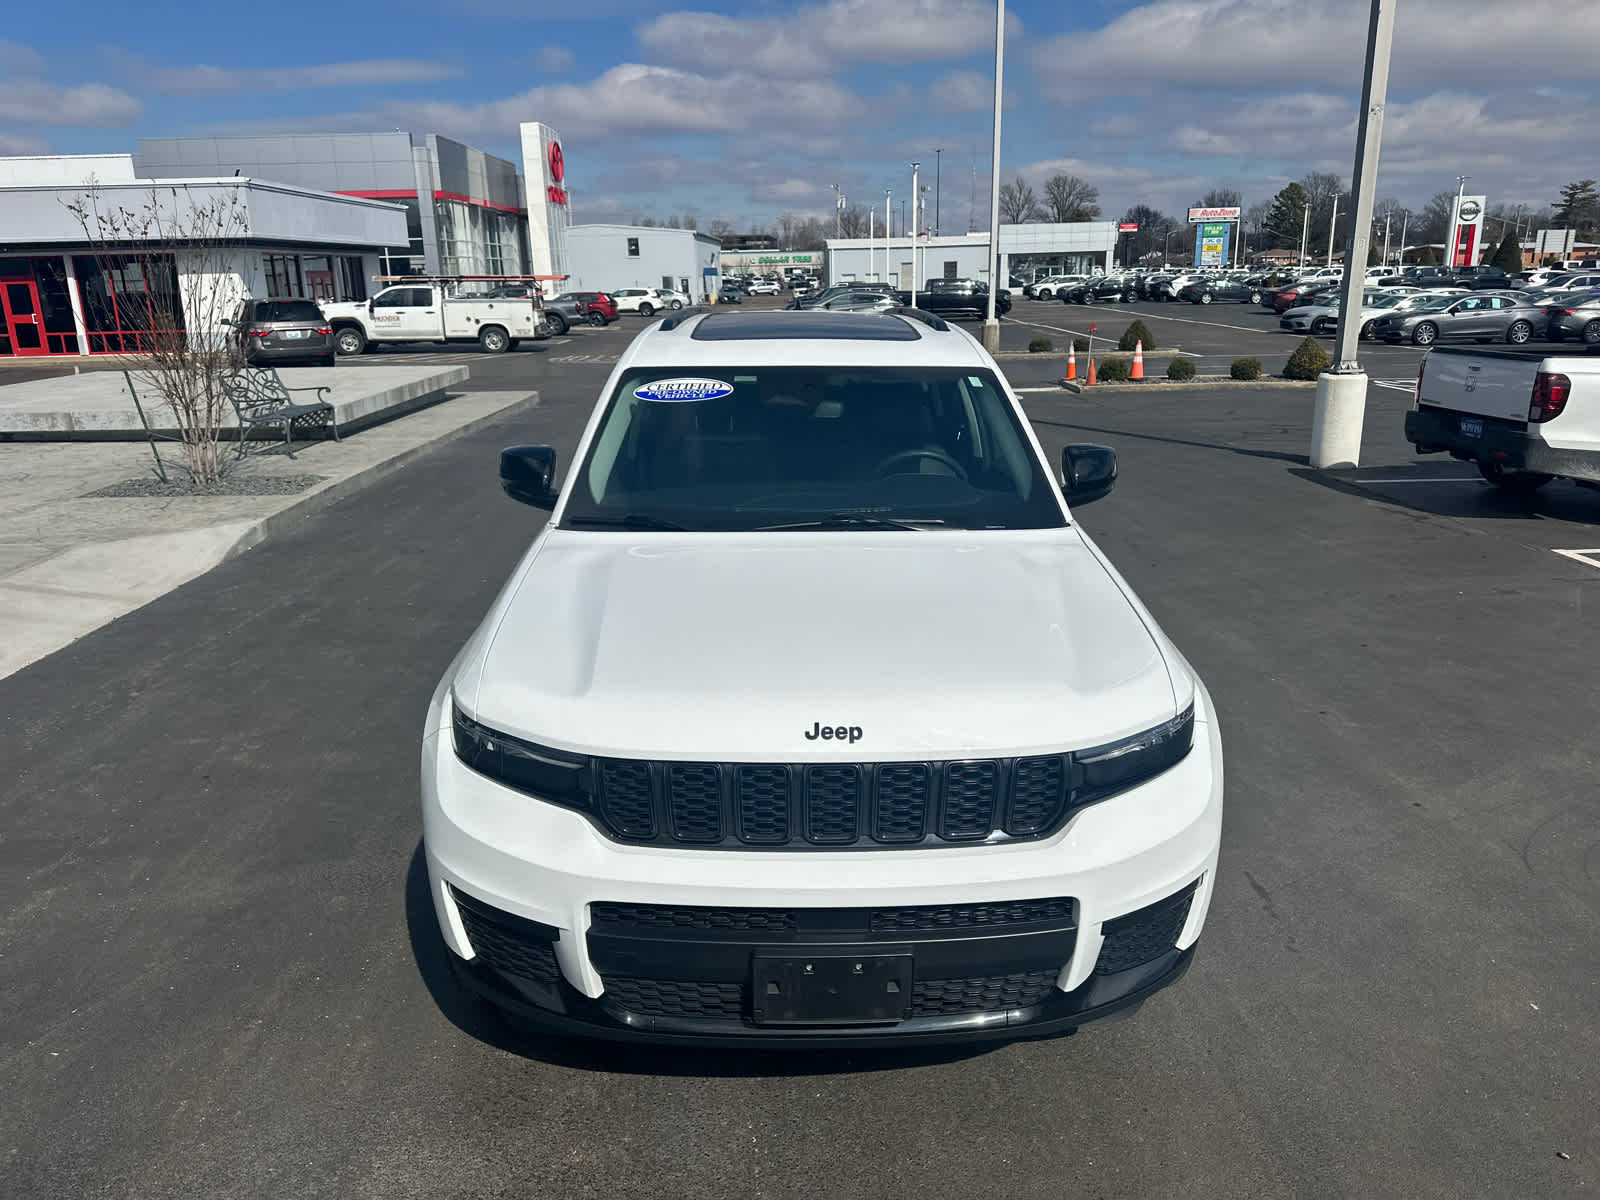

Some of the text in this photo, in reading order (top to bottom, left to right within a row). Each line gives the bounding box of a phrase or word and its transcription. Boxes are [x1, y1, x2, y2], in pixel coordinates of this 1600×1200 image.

[1200, 208, 1237, 217] AutoZone
[1460, 206, 1481, 215] NISSAN
[647, 383, 723, 391] CERTIFIED
[804, 721, 863, 744] Jeep
